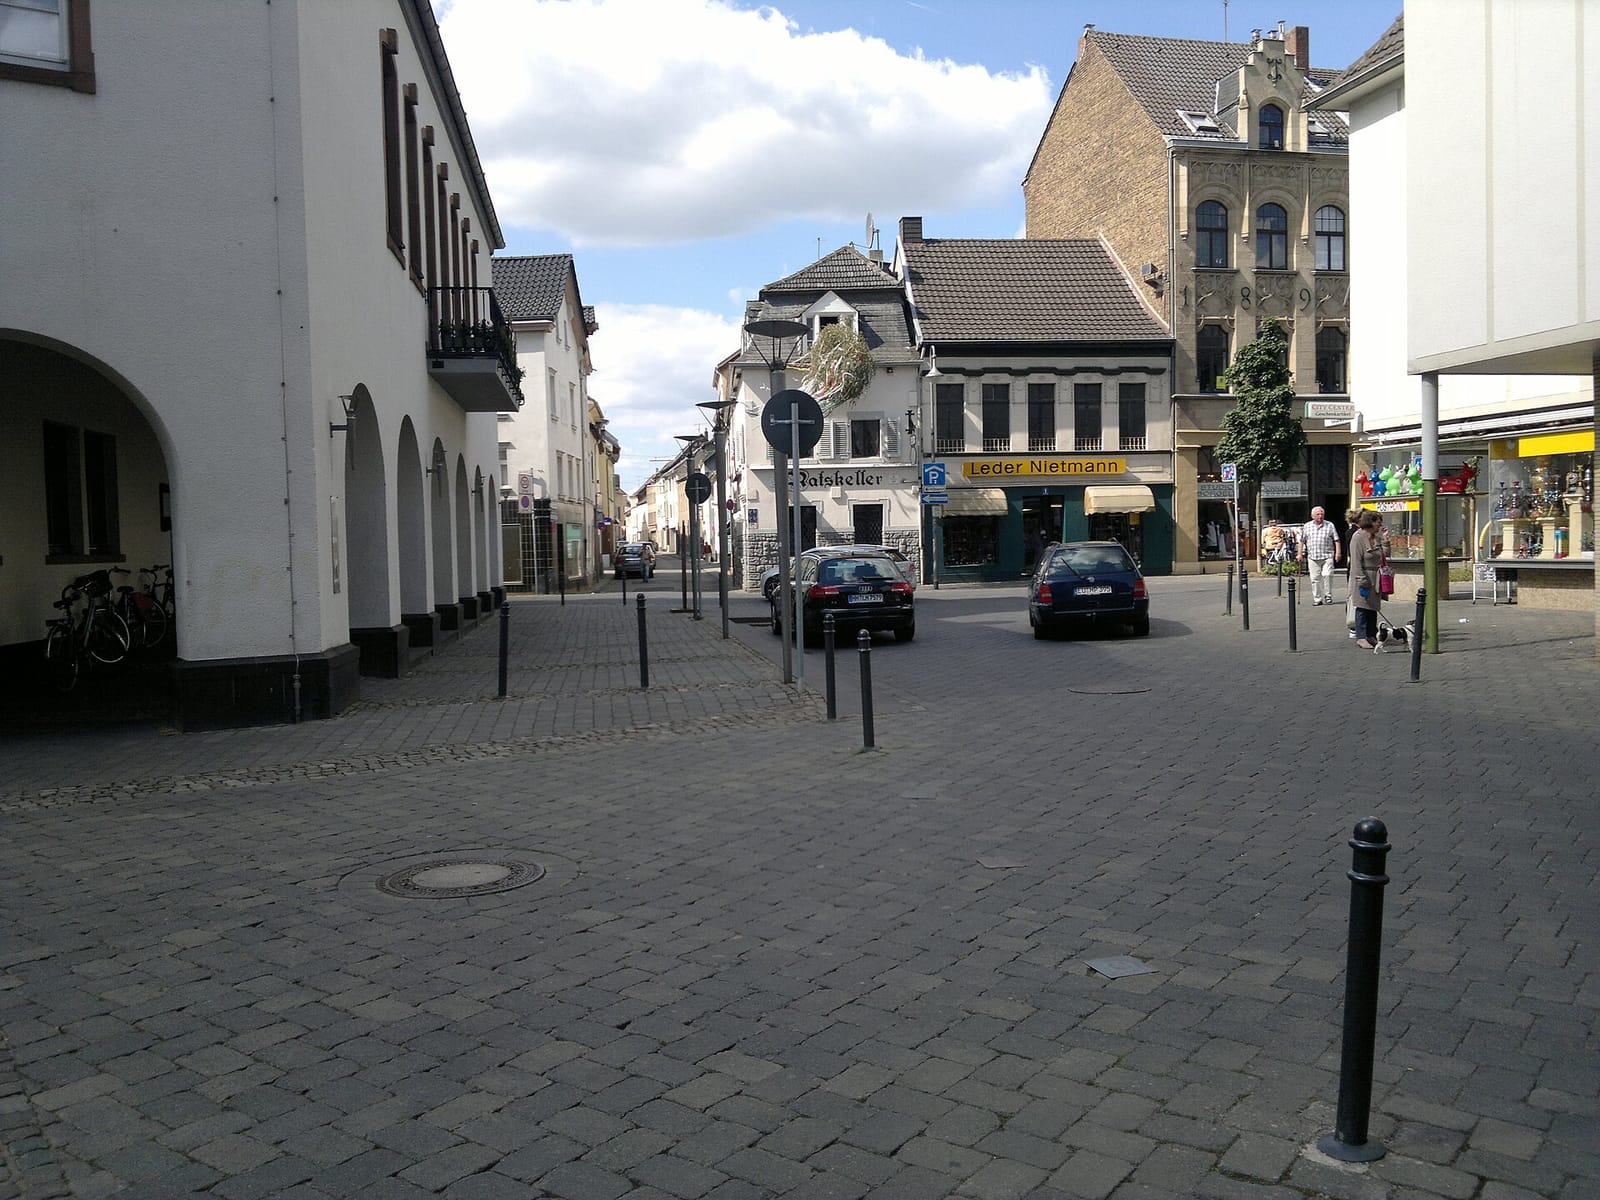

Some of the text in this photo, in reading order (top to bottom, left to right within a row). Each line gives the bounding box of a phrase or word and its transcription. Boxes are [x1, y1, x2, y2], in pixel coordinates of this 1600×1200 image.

[1240, 286, 1251, 311] 8
[1300, 288, 1311, 312] 9
[971, 460, 1119, 475] Leder Nietmann
